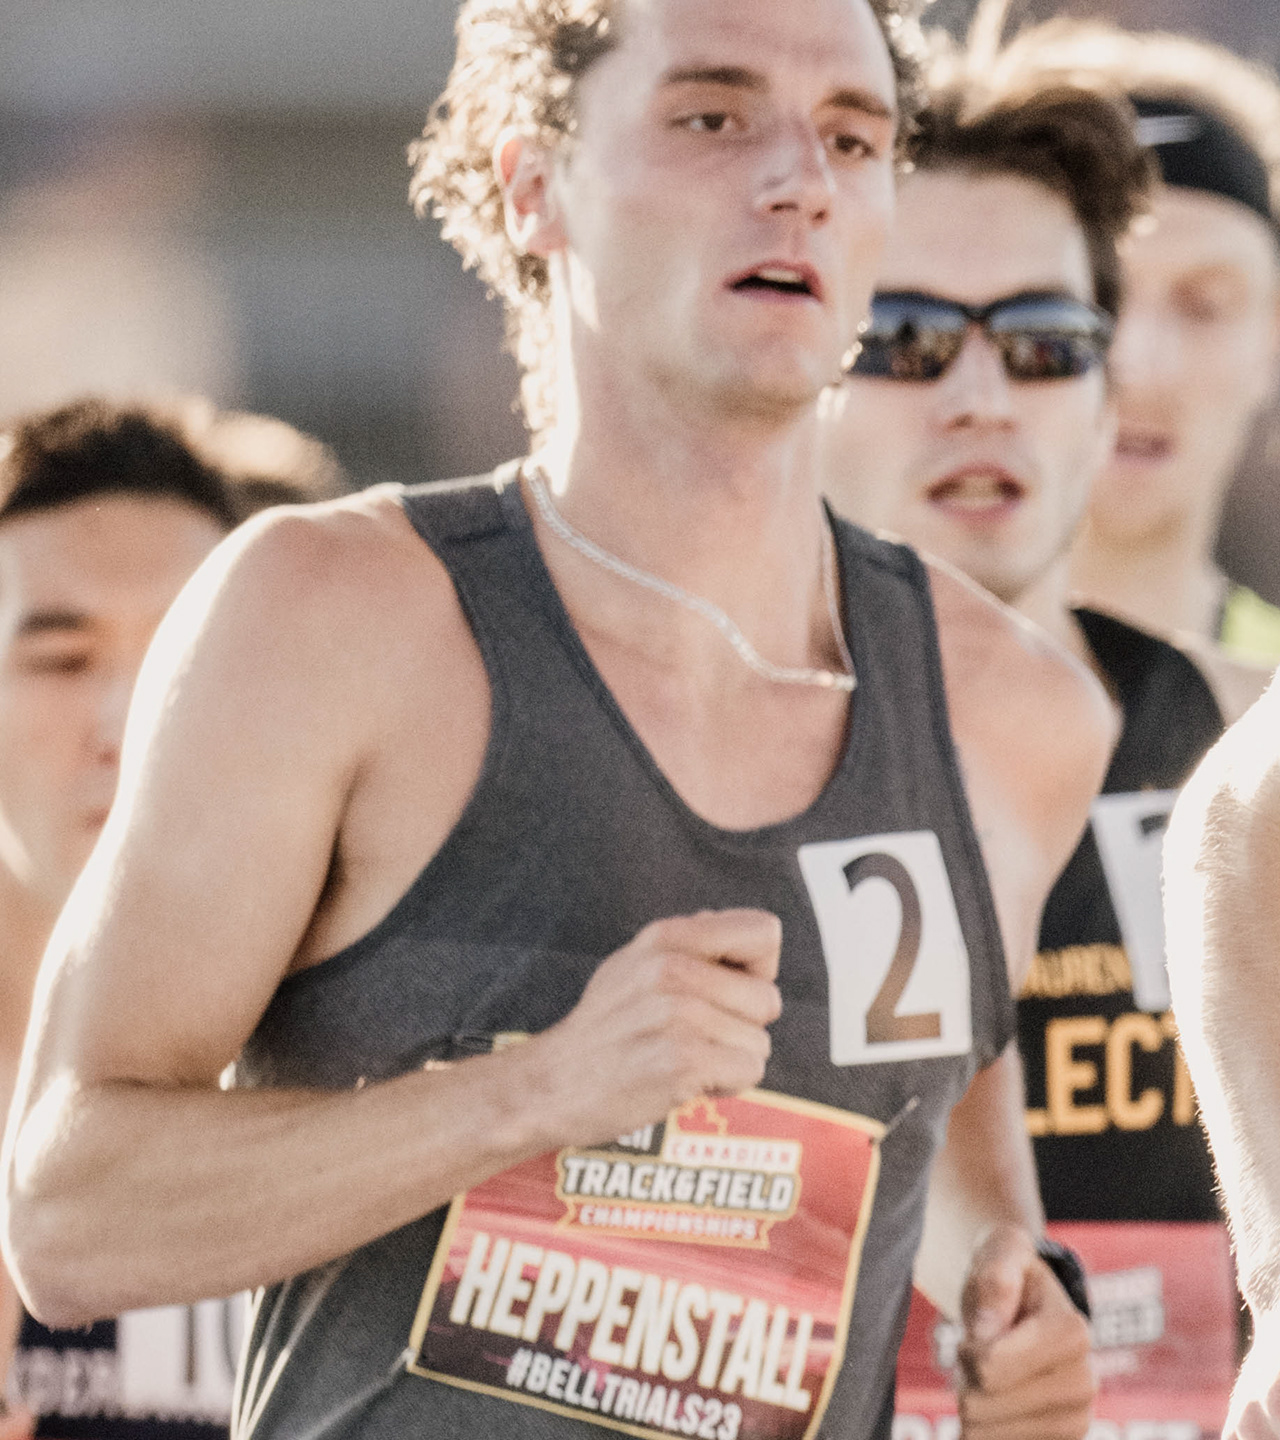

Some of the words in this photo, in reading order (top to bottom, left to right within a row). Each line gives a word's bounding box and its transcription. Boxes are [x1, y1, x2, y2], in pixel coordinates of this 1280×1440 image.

[842, 852, 942, 1044] 2
[671, 1143, 792, 1165] CANADIAN
[563, 1156, 795, 1212] TRACK&FIELD
[579, 1205, 757, 1241] CHAMPIONSHIPS
[449, 1232, 813, 1413] HEPPENSTALL
